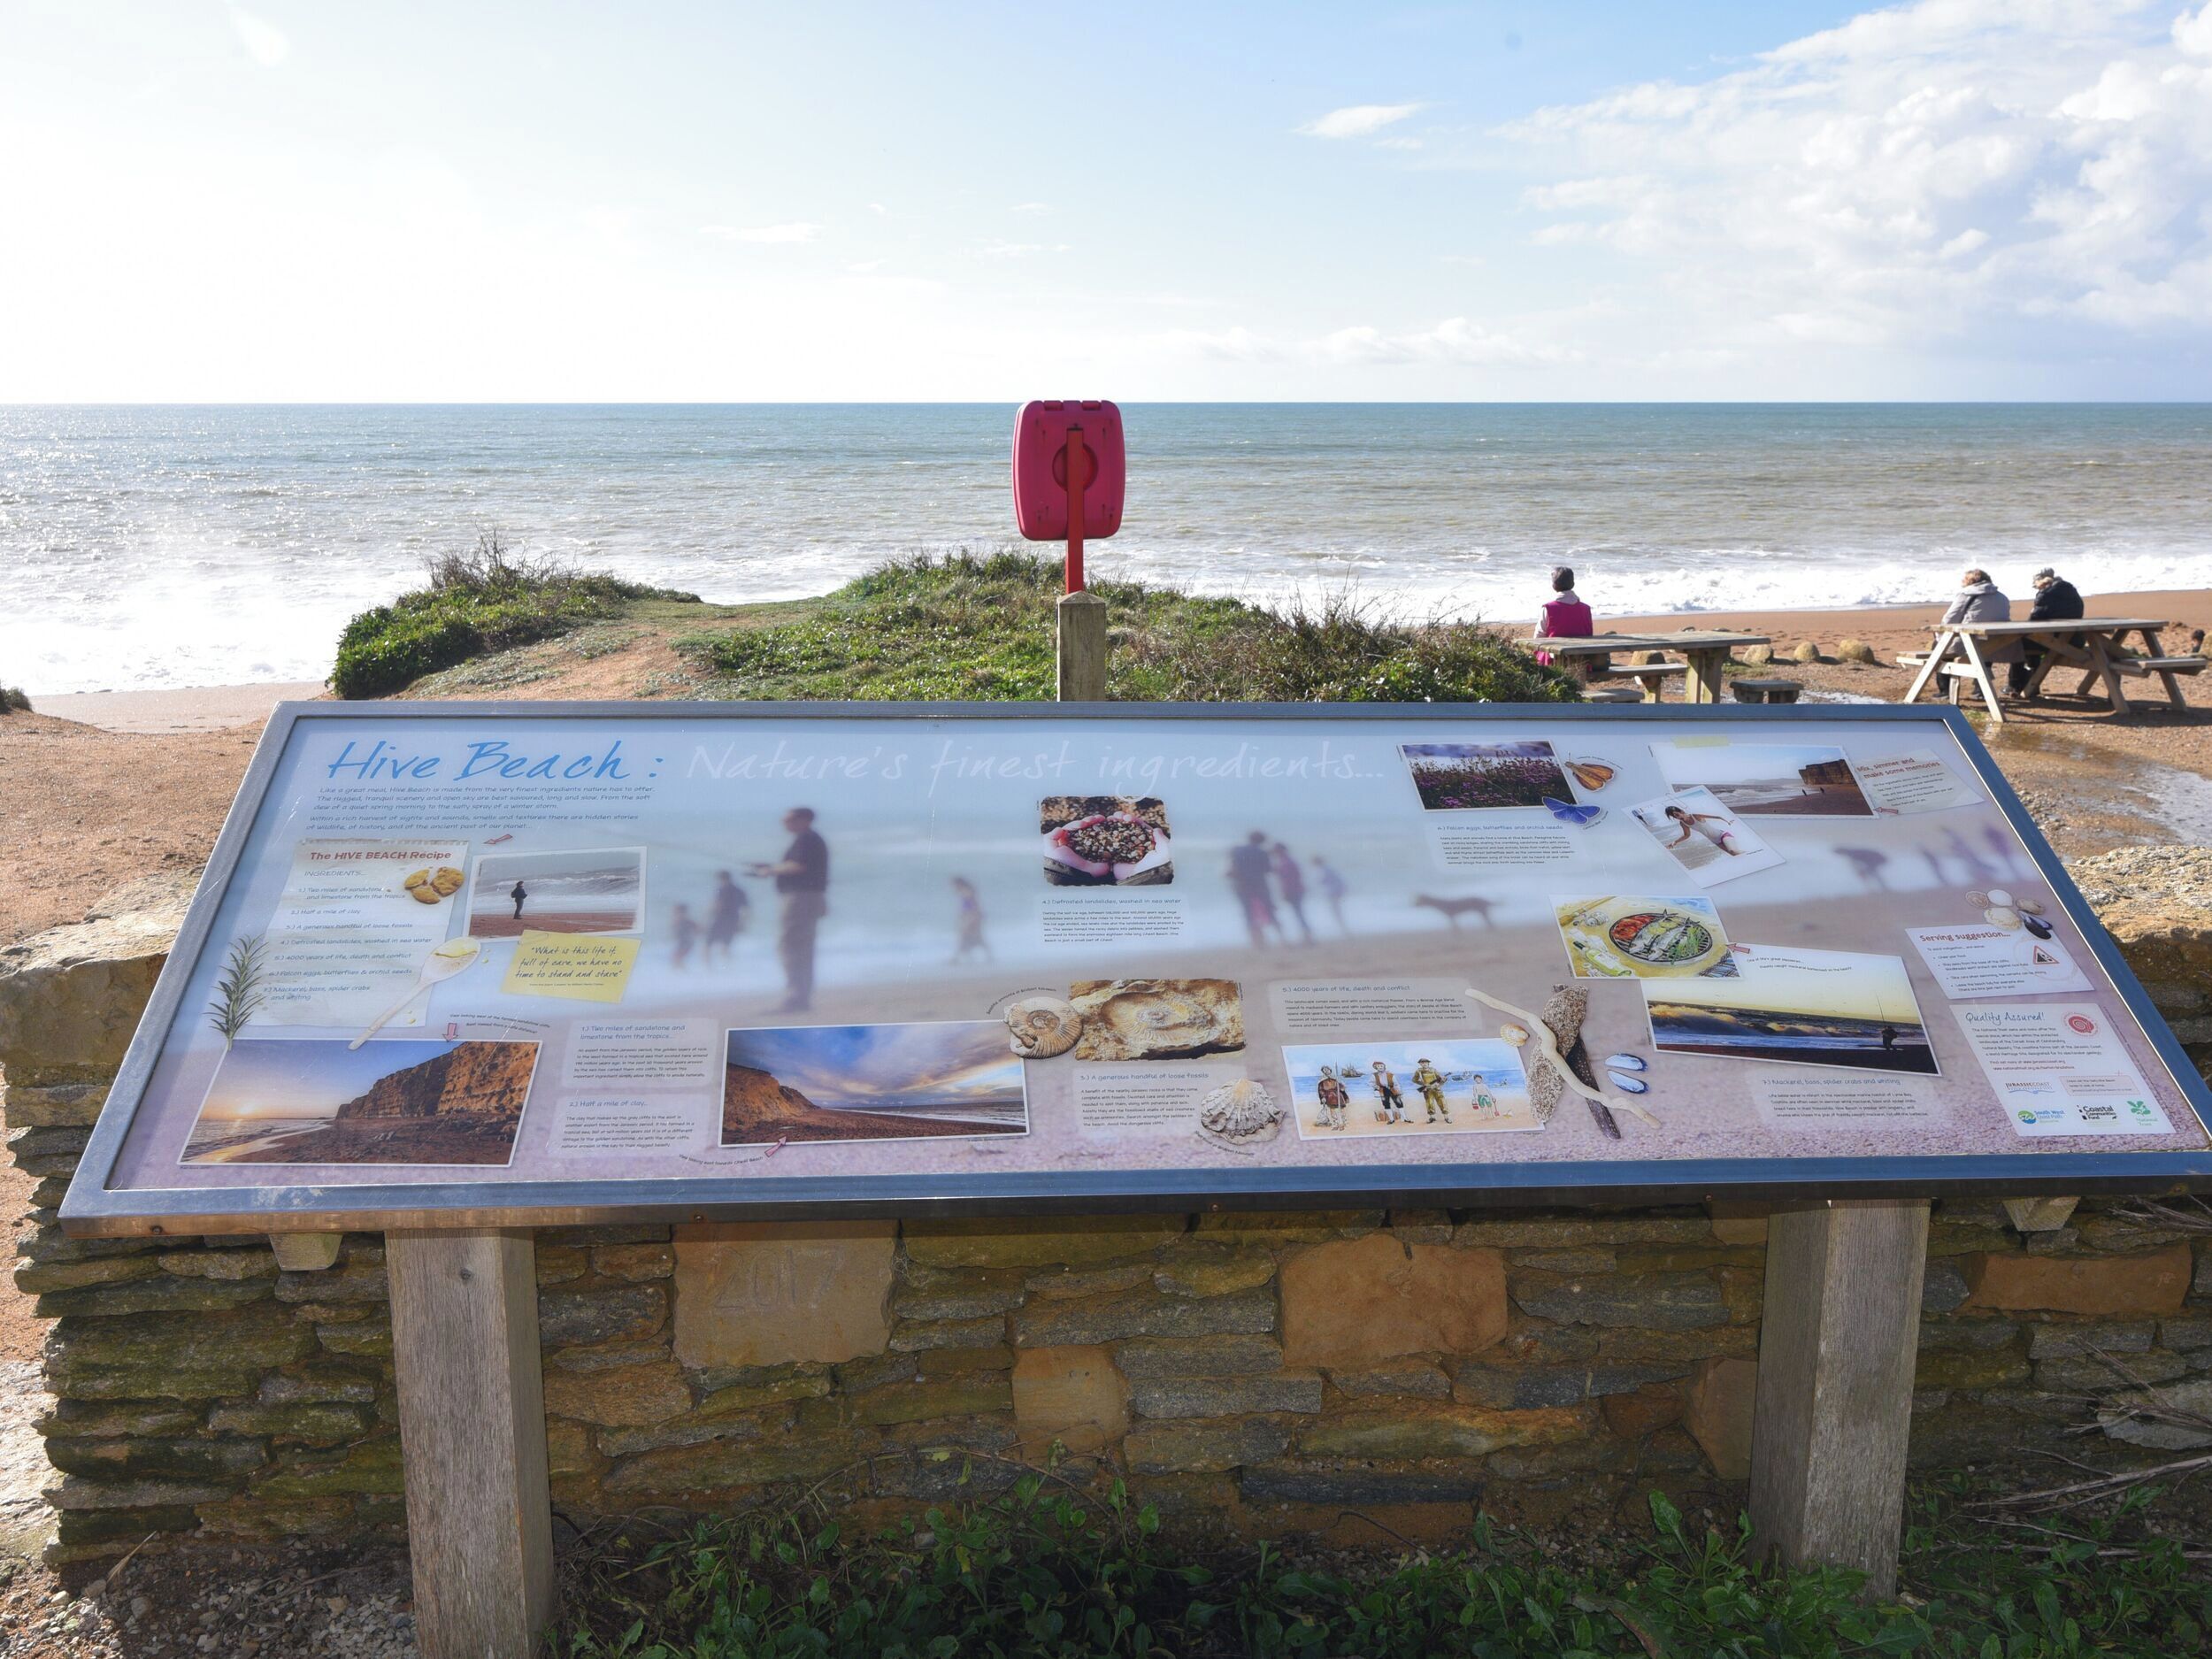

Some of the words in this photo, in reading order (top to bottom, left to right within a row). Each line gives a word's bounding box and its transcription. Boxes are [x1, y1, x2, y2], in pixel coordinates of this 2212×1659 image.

[328, 741, 441, 780] Hive
[453, 740, 630, 780] Beach
[649, 757, 663, 778] :
[686, 739, 908, 780] Nature's
[929, 740, 1076, 797] finest
[1097, 740, 1385, 801] ingredients...
[411, 851, 451, 860] Recipe
[1955, 932, 2010, 941] suggestion...
[1965, 1012, 2001, 1025] Quality
[2005, 1012, 2045, 1021] Assured!
[714, 1246, 838, 1310] 2017
